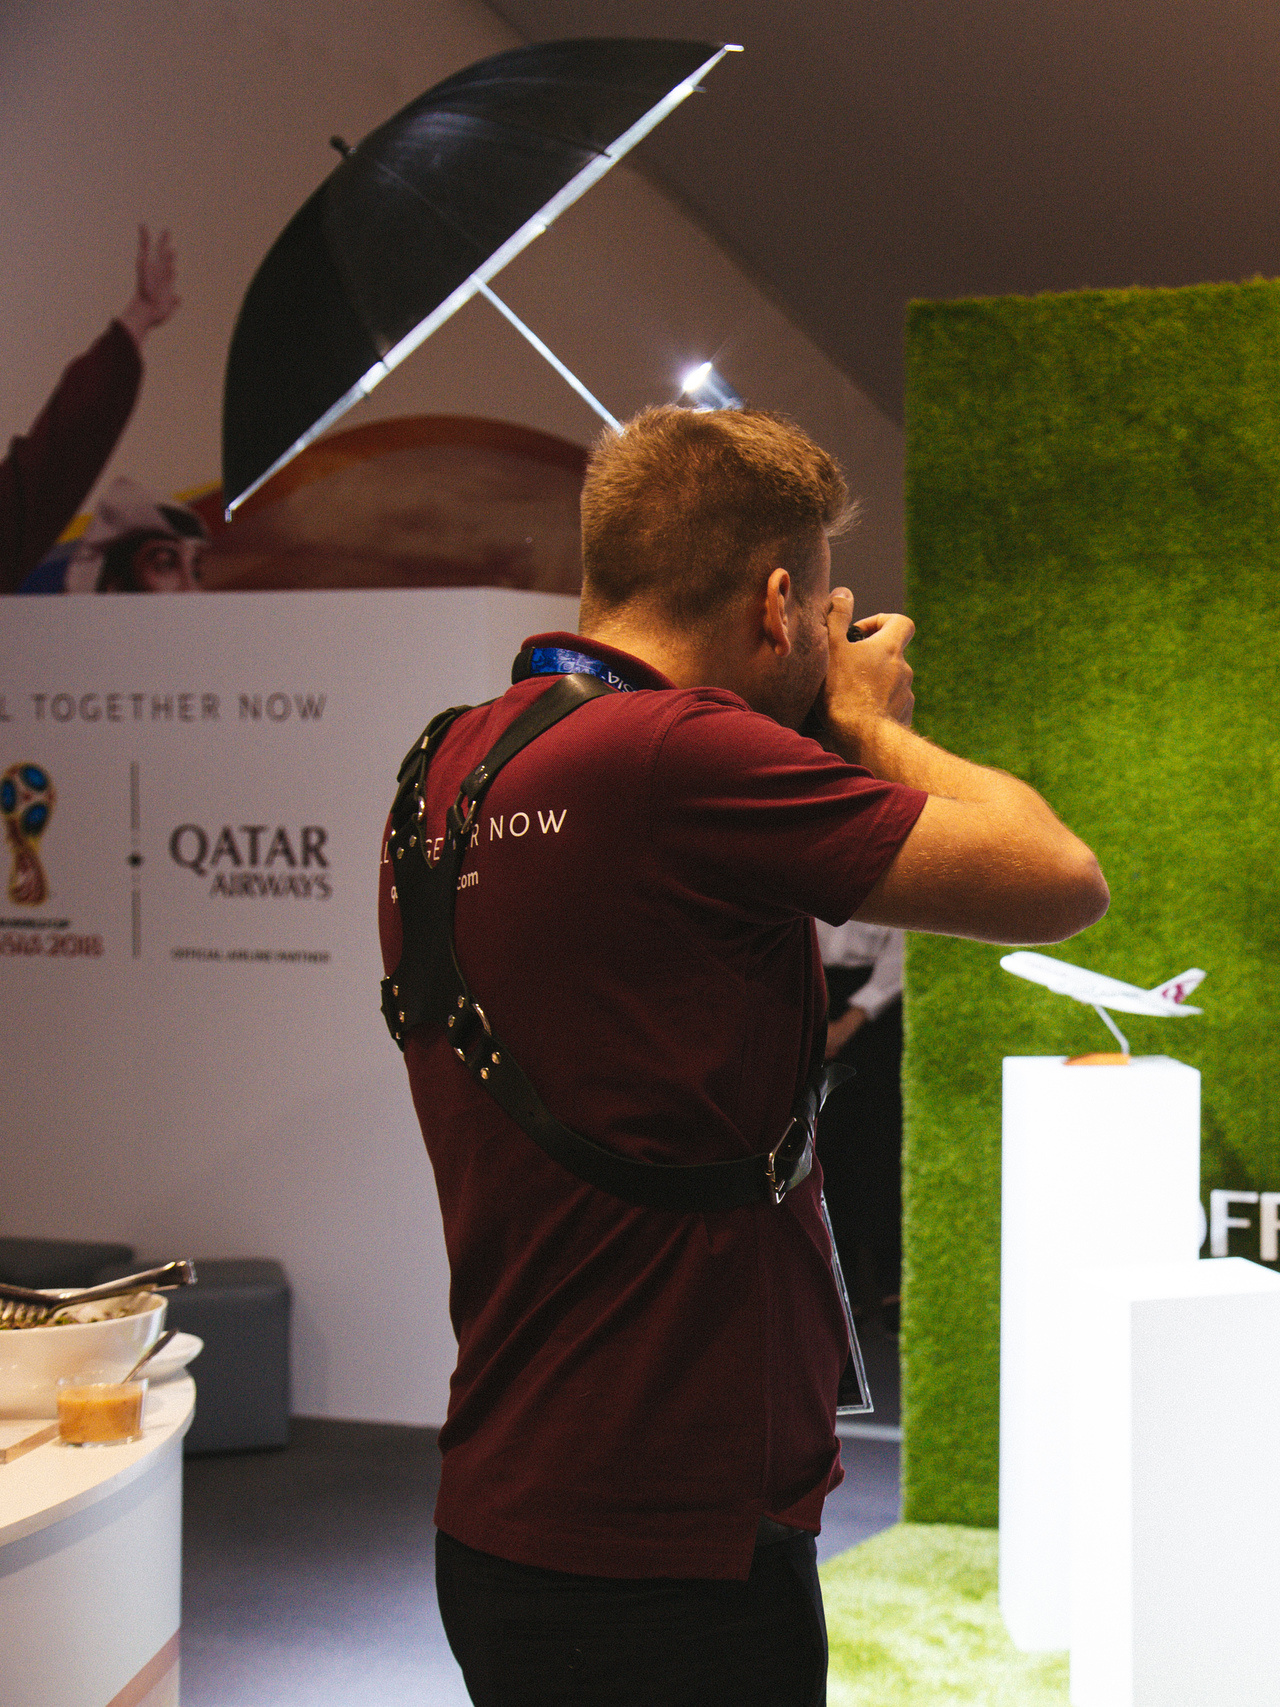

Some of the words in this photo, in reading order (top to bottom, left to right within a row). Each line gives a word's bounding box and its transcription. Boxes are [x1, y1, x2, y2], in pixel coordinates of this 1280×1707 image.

[32, 692, 221, 722] TOGETHER
[238, 692, 327, 721] NOW
[489, 809, 567, 841] NOW
[168, 823, 330, 876] QATAR
[209, 873, 332, 899] AIRWAYS
